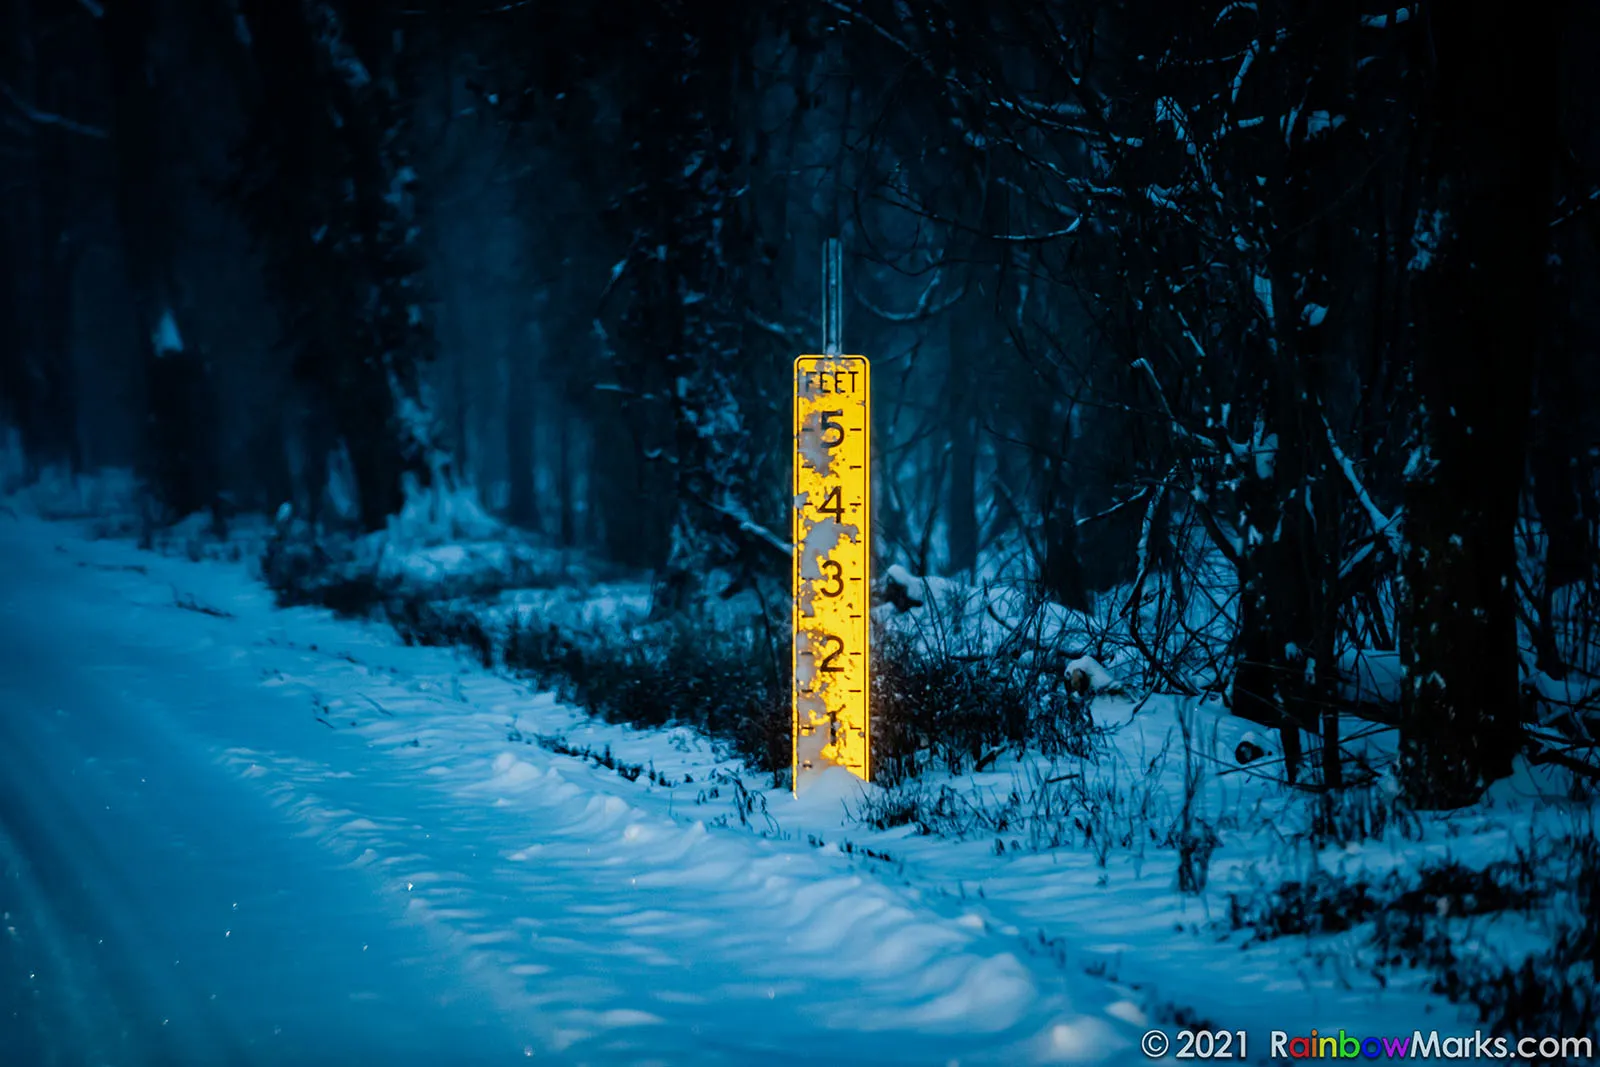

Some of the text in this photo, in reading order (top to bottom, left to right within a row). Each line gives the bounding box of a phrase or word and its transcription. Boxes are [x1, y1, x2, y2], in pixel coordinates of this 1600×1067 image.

[820, 410, 845, 448] 5
[816, 485, 845, 524] 4
[820, 560, 845, 597] 3
[820, 635, 845, 672] 2
[826, 710, 838, 747] 1
